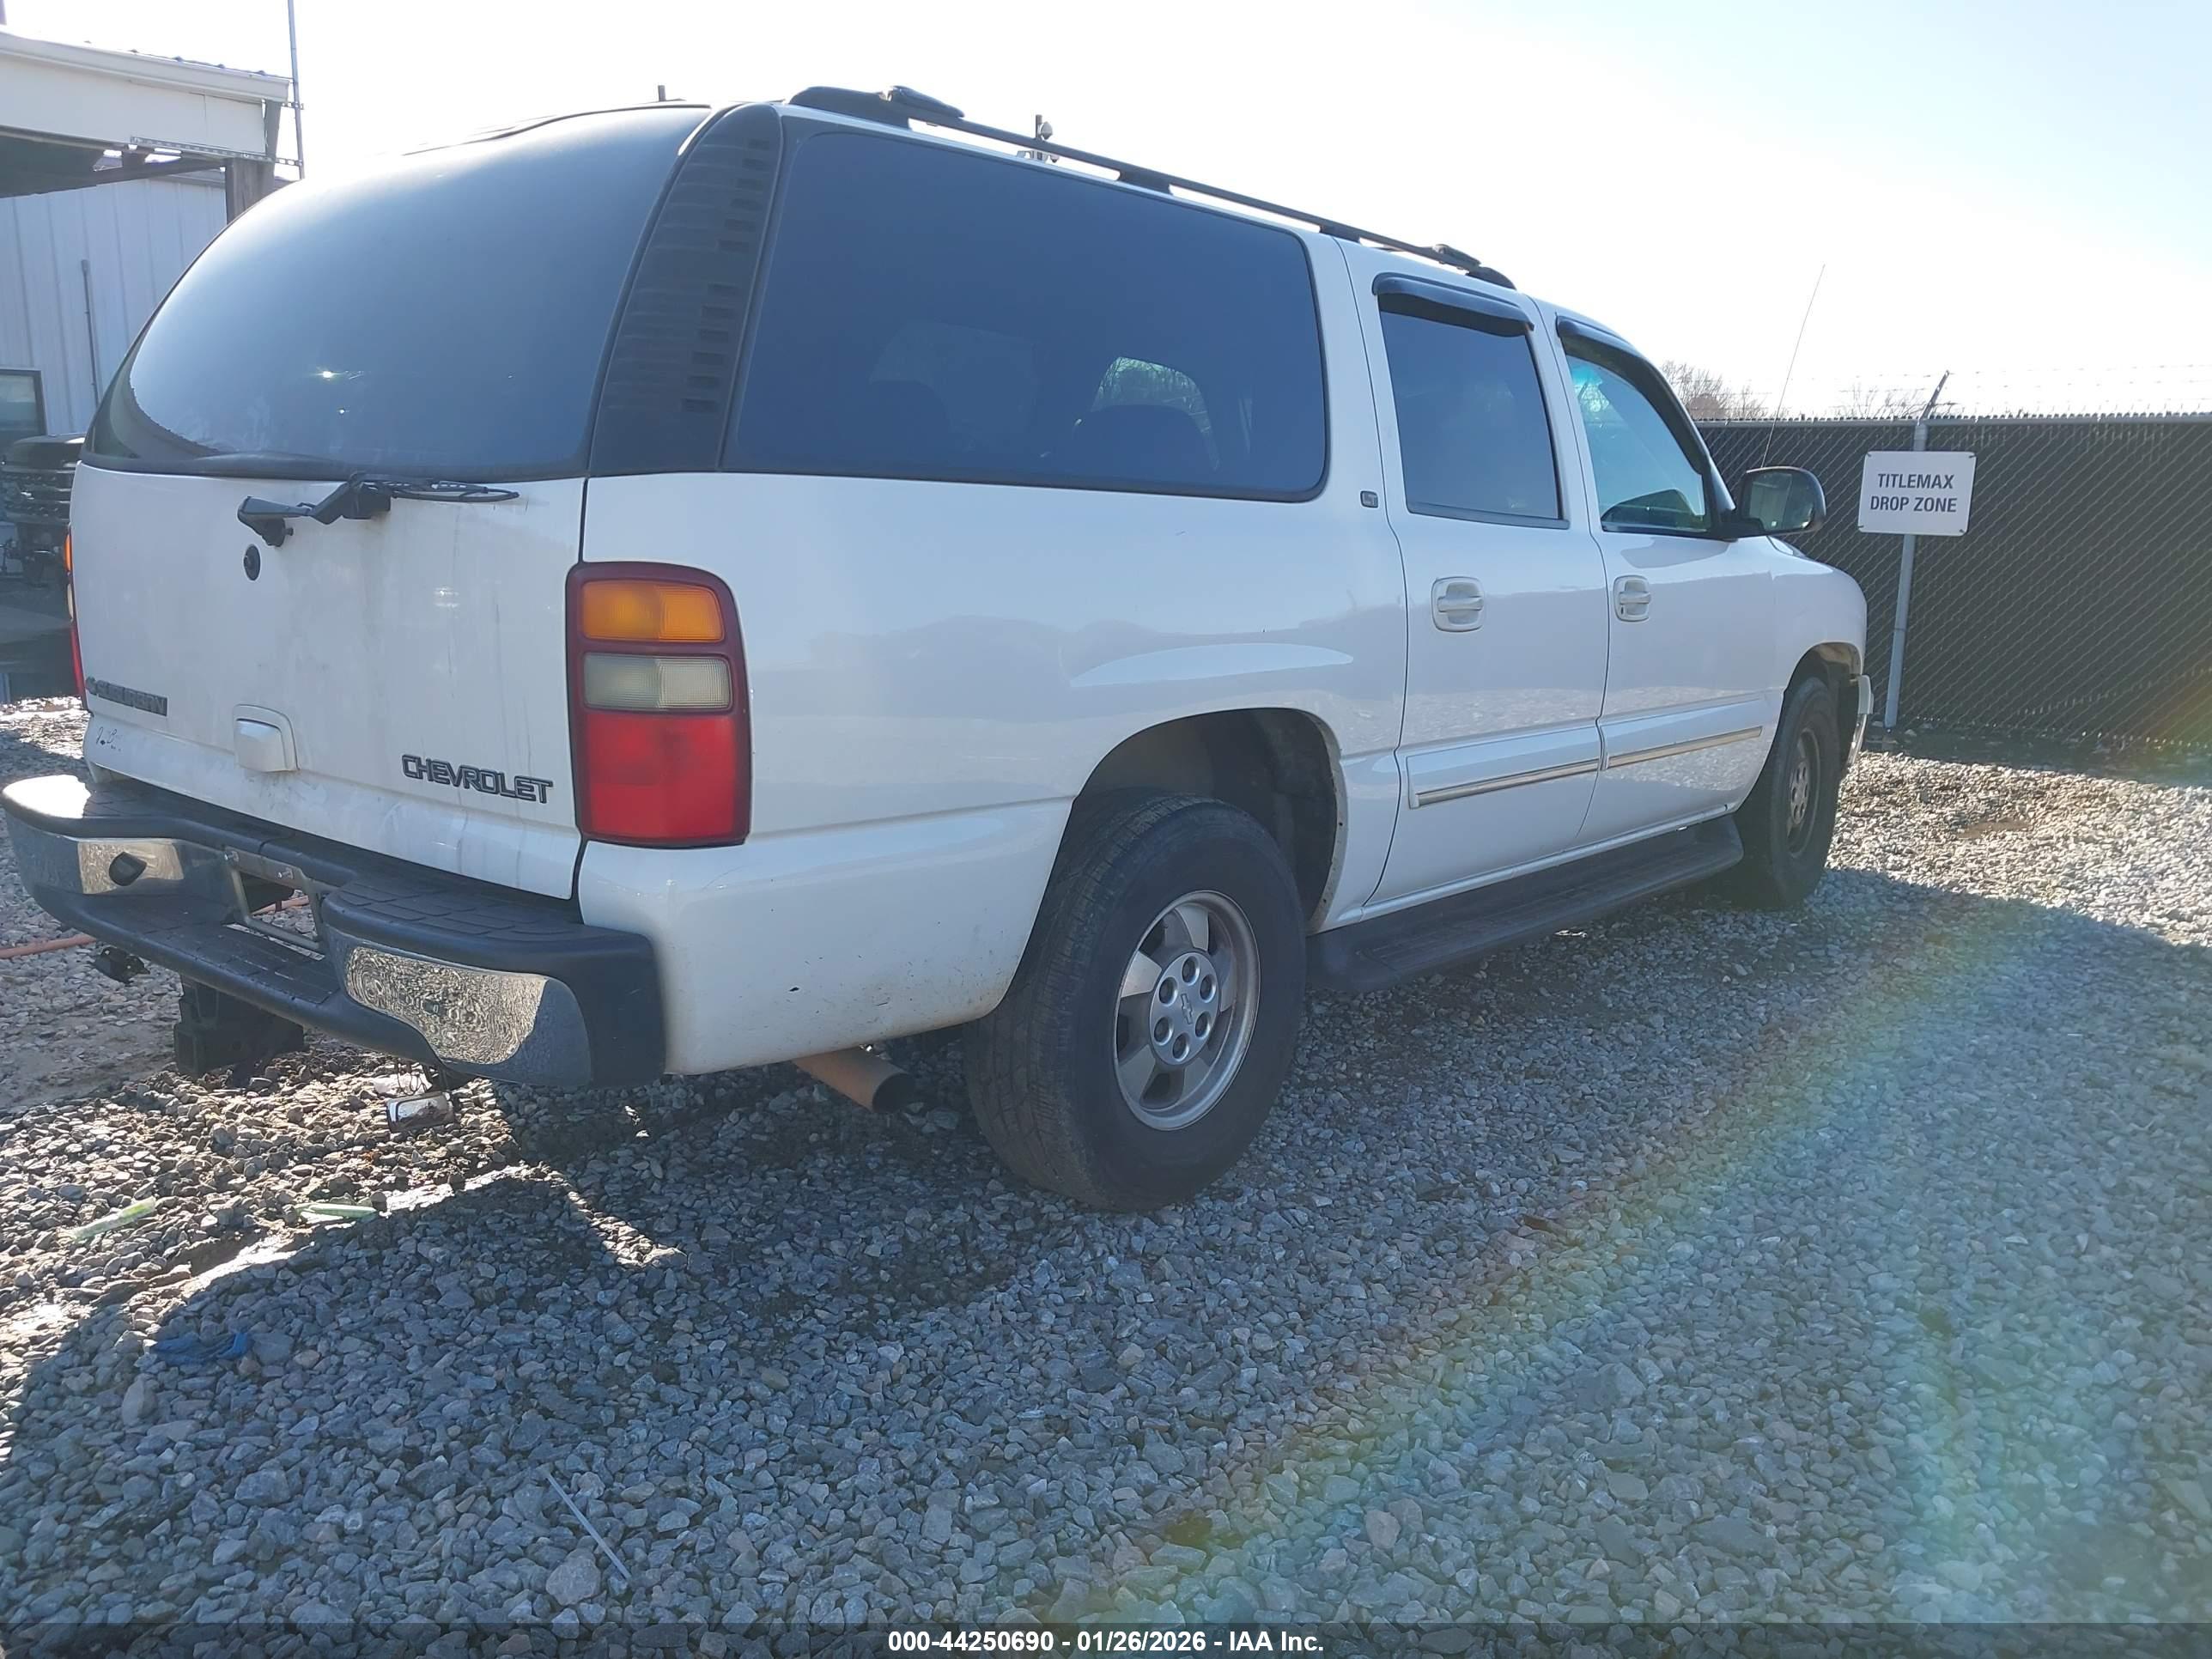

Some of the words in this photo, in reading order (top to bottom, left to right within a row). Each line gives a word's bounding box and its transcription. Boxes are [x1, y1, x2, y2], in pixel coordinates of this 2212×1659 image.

[1878, 473, 1954, 489] TITLEMAX
[1870, 495, 1910, 511] DROP
[1913, 497, 1958, 513] ZONE
[402, 754, 554, 804] CHEVROLET
